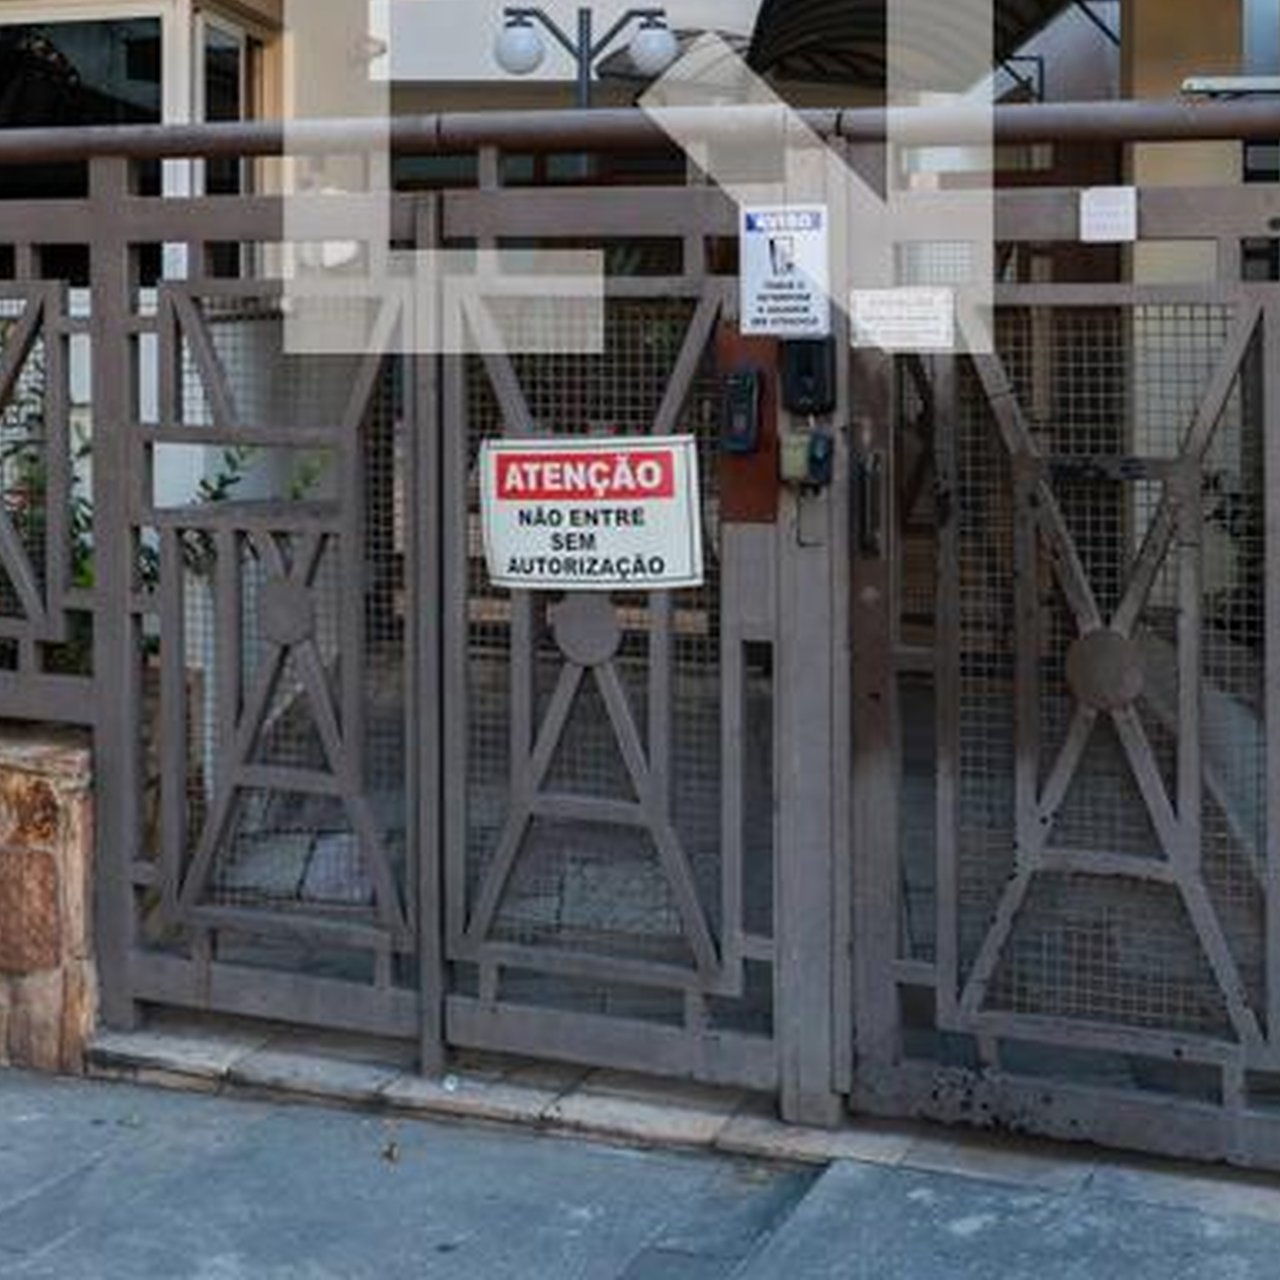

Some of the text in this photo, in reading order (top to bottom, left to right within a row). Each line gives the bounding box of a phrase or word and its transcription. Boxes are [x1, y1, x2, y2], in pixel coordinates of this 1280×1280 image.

[504, 454, 663, 497] ATENÇÃO
[518, 507, 646, 527] NÃO ENTRE
[550, 532, 596, 551] SEM
[506, 554, 666, 581] AUTORIZAÇÃO
